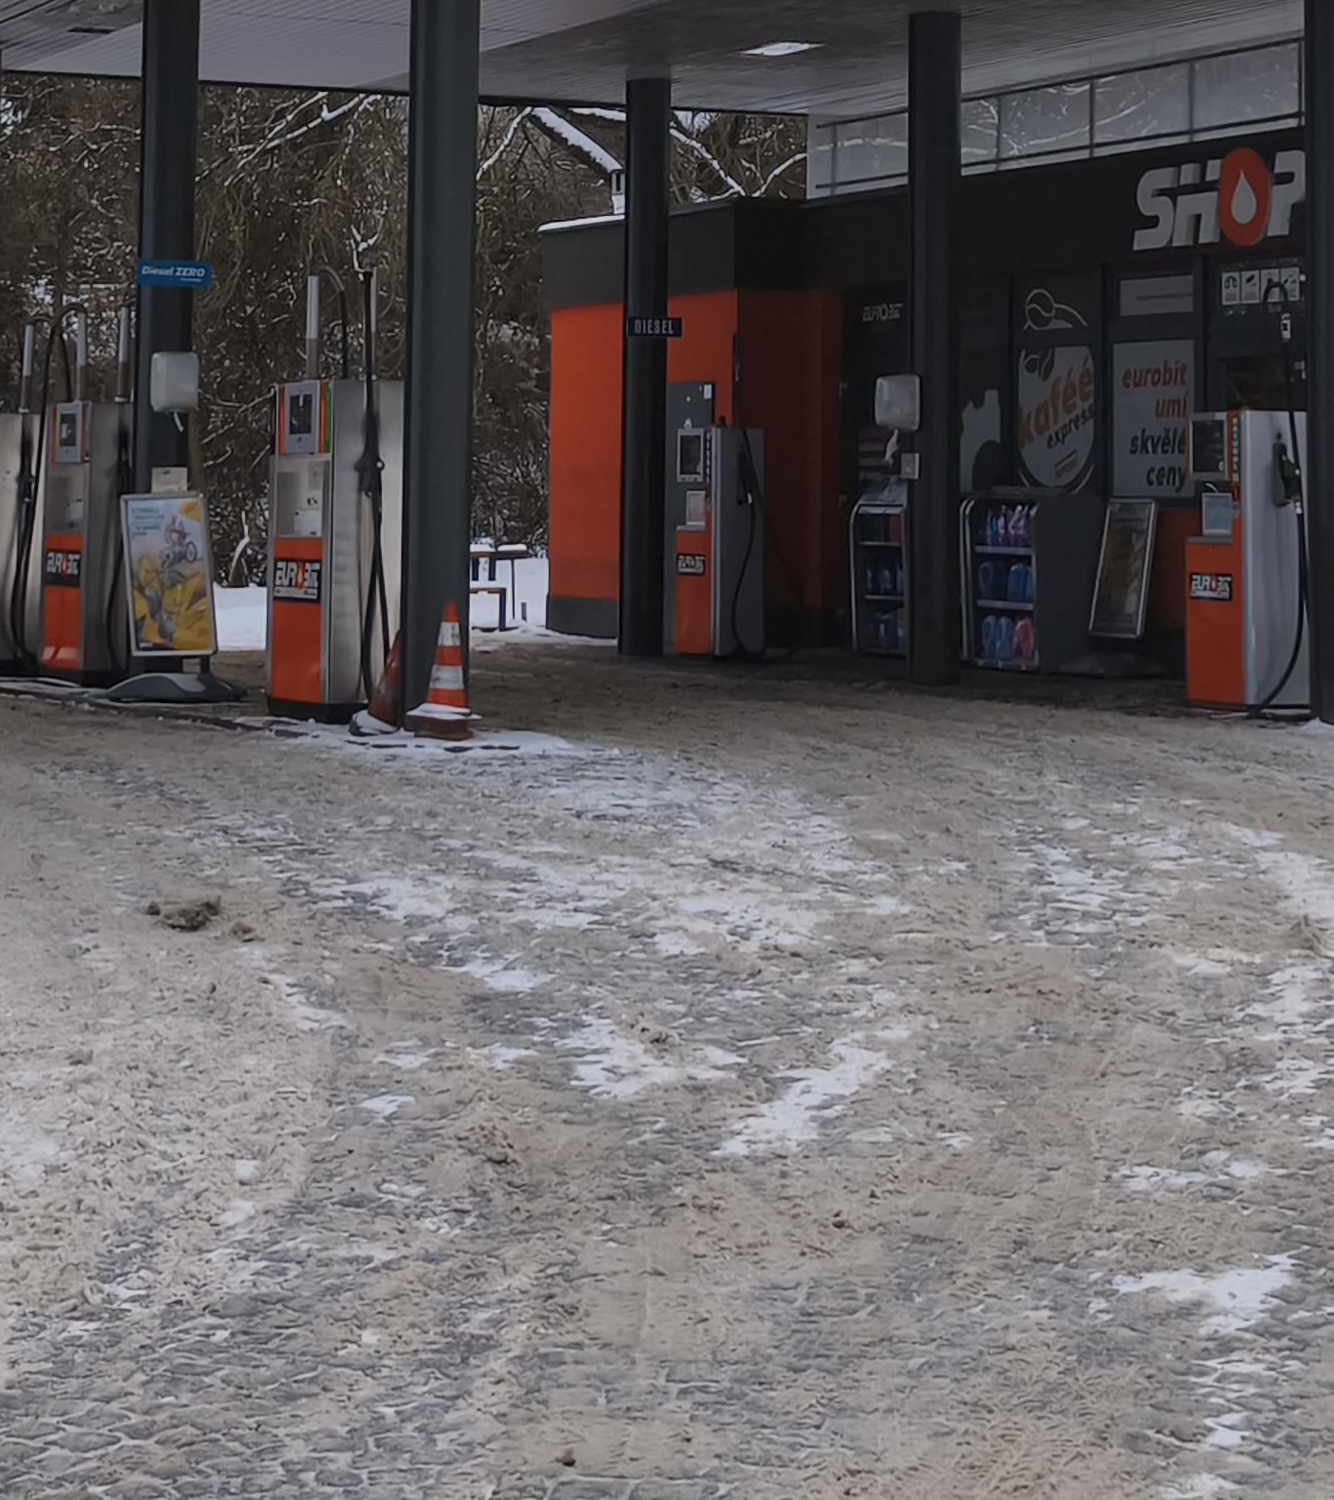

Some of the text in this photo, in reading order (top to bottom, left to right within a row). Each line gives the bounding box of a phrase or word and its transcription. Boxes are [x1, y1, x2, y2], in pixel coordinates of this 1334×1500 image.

[1133, 147, 1307, 250] SHOP
[175, 267, 206, 277] ZERO
[634, 319, 674, 334] DIESEL
[1123, 360, 1187, 388] eurobit
[1155, 391, 1189, 419] umí
[1047, 403, 1100, 449] express
[1146, 466, 1185, 493] ceny
